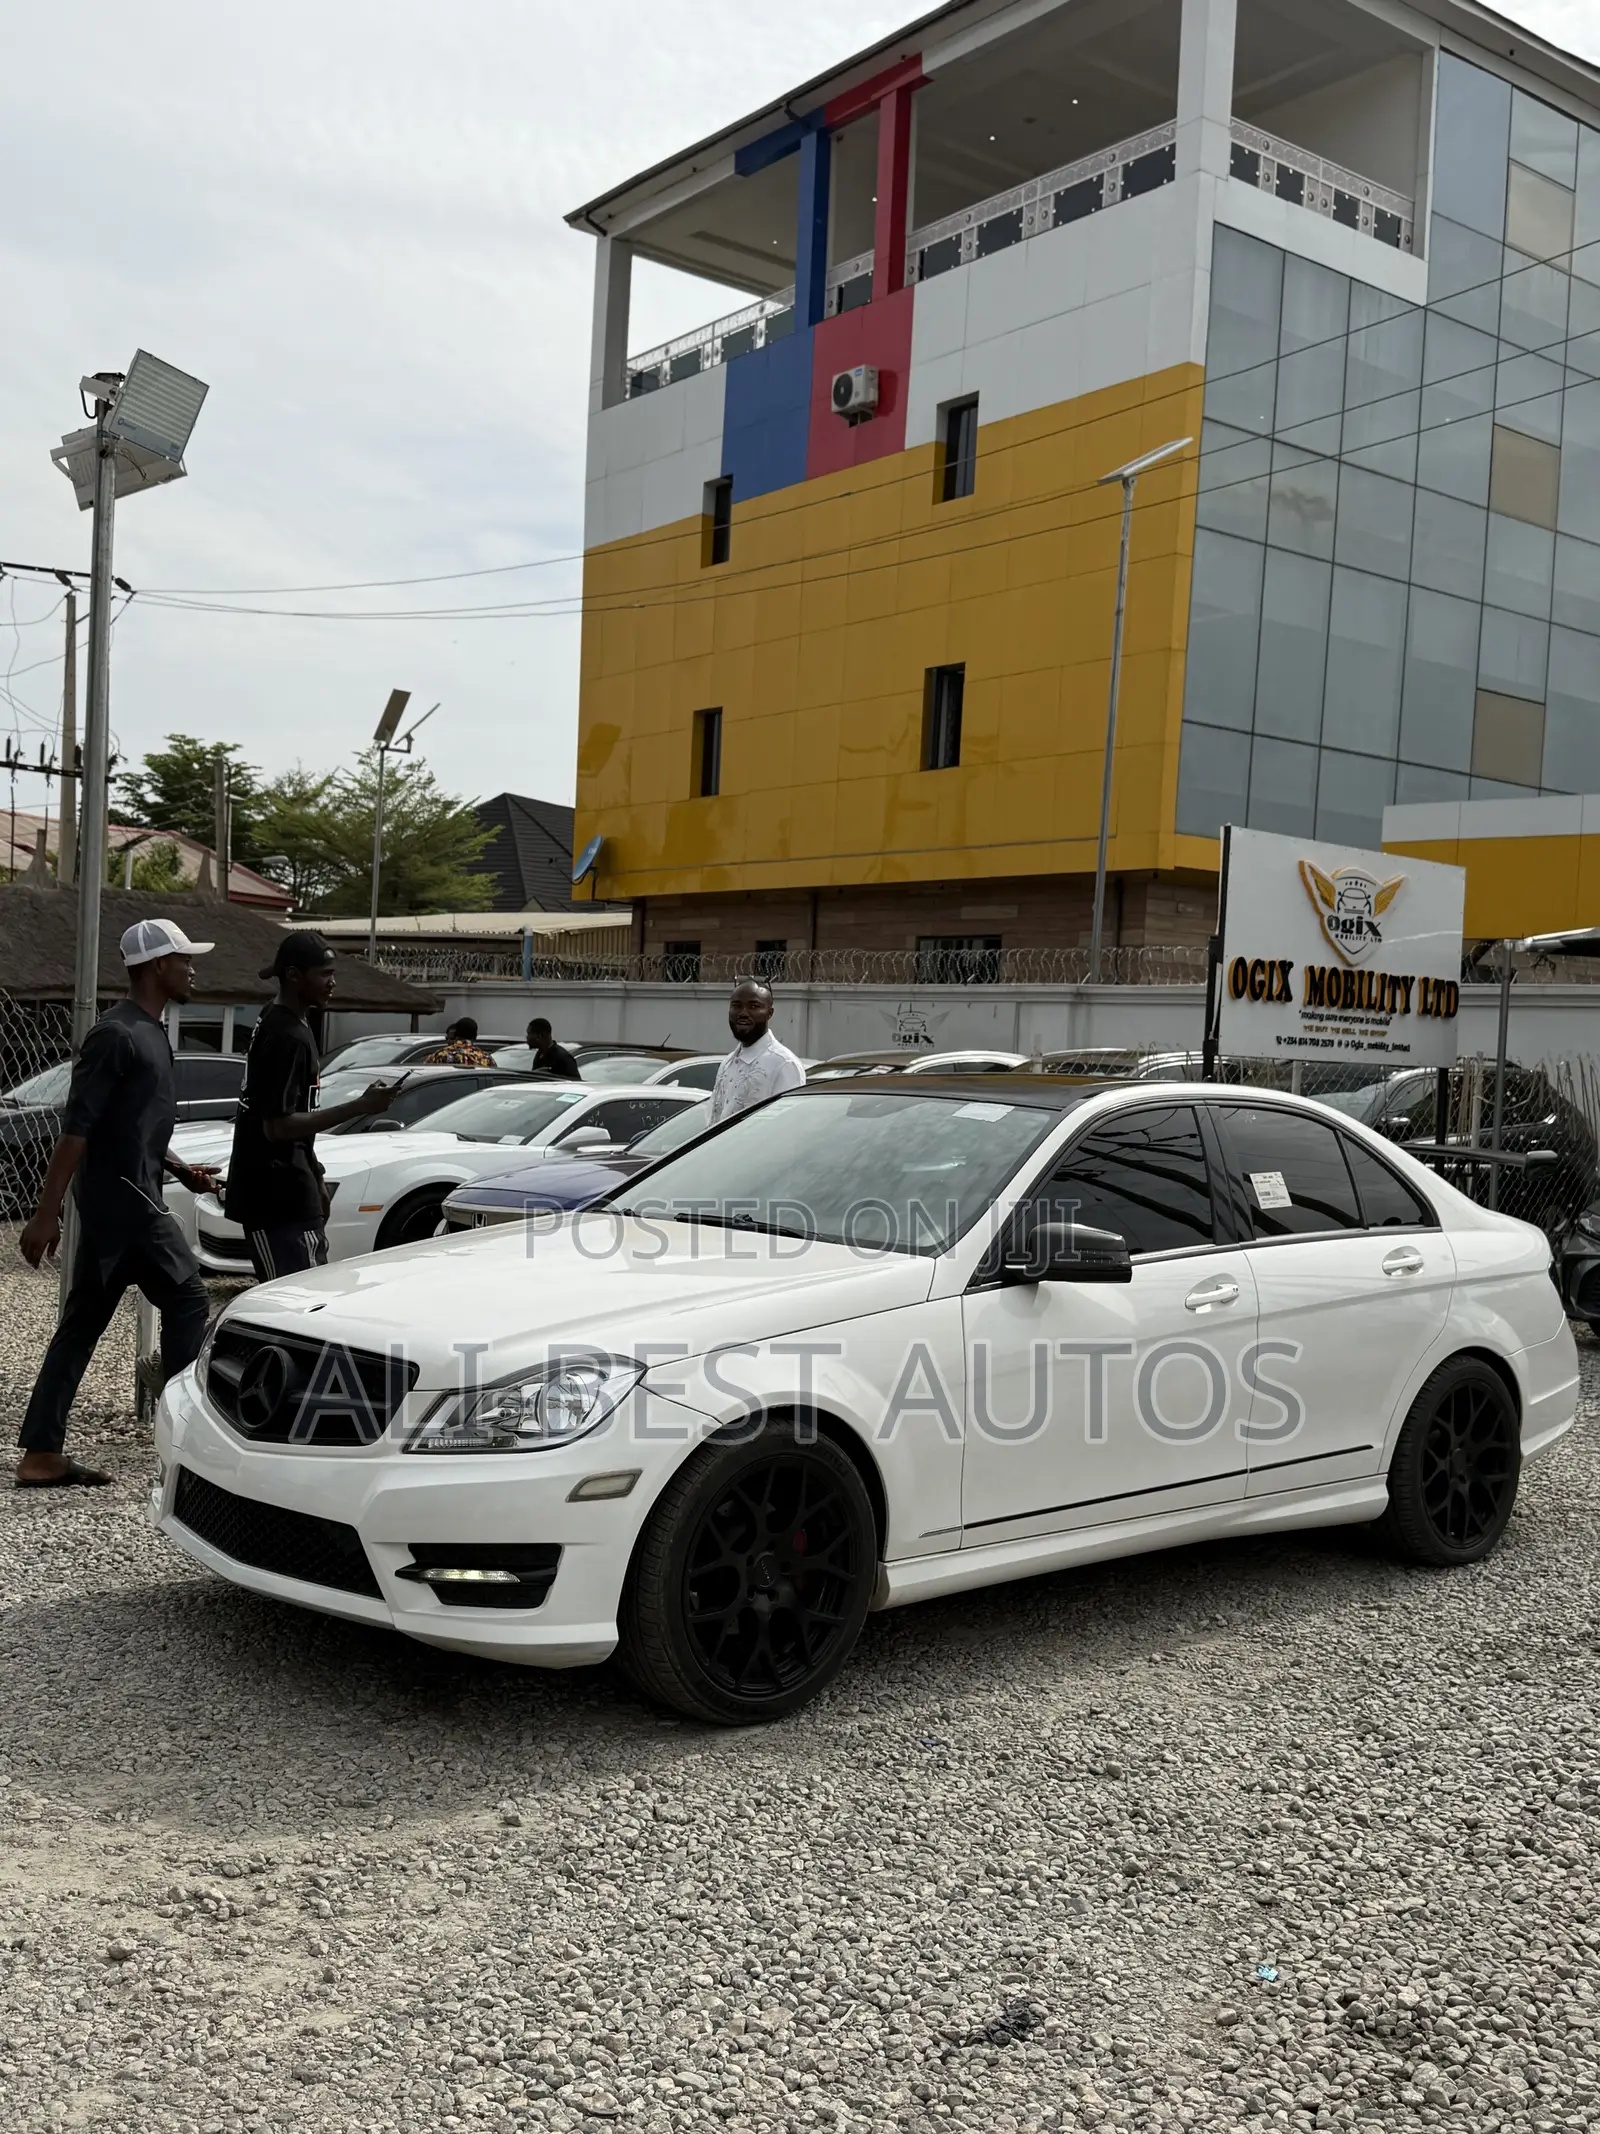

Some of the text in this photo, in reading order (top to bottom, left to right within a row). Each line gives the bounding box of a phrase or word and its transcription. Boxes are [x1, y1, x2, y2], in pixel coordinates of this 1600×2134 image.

[1228, 956, 1460, 1019] OGIX MOBILITY LTD
